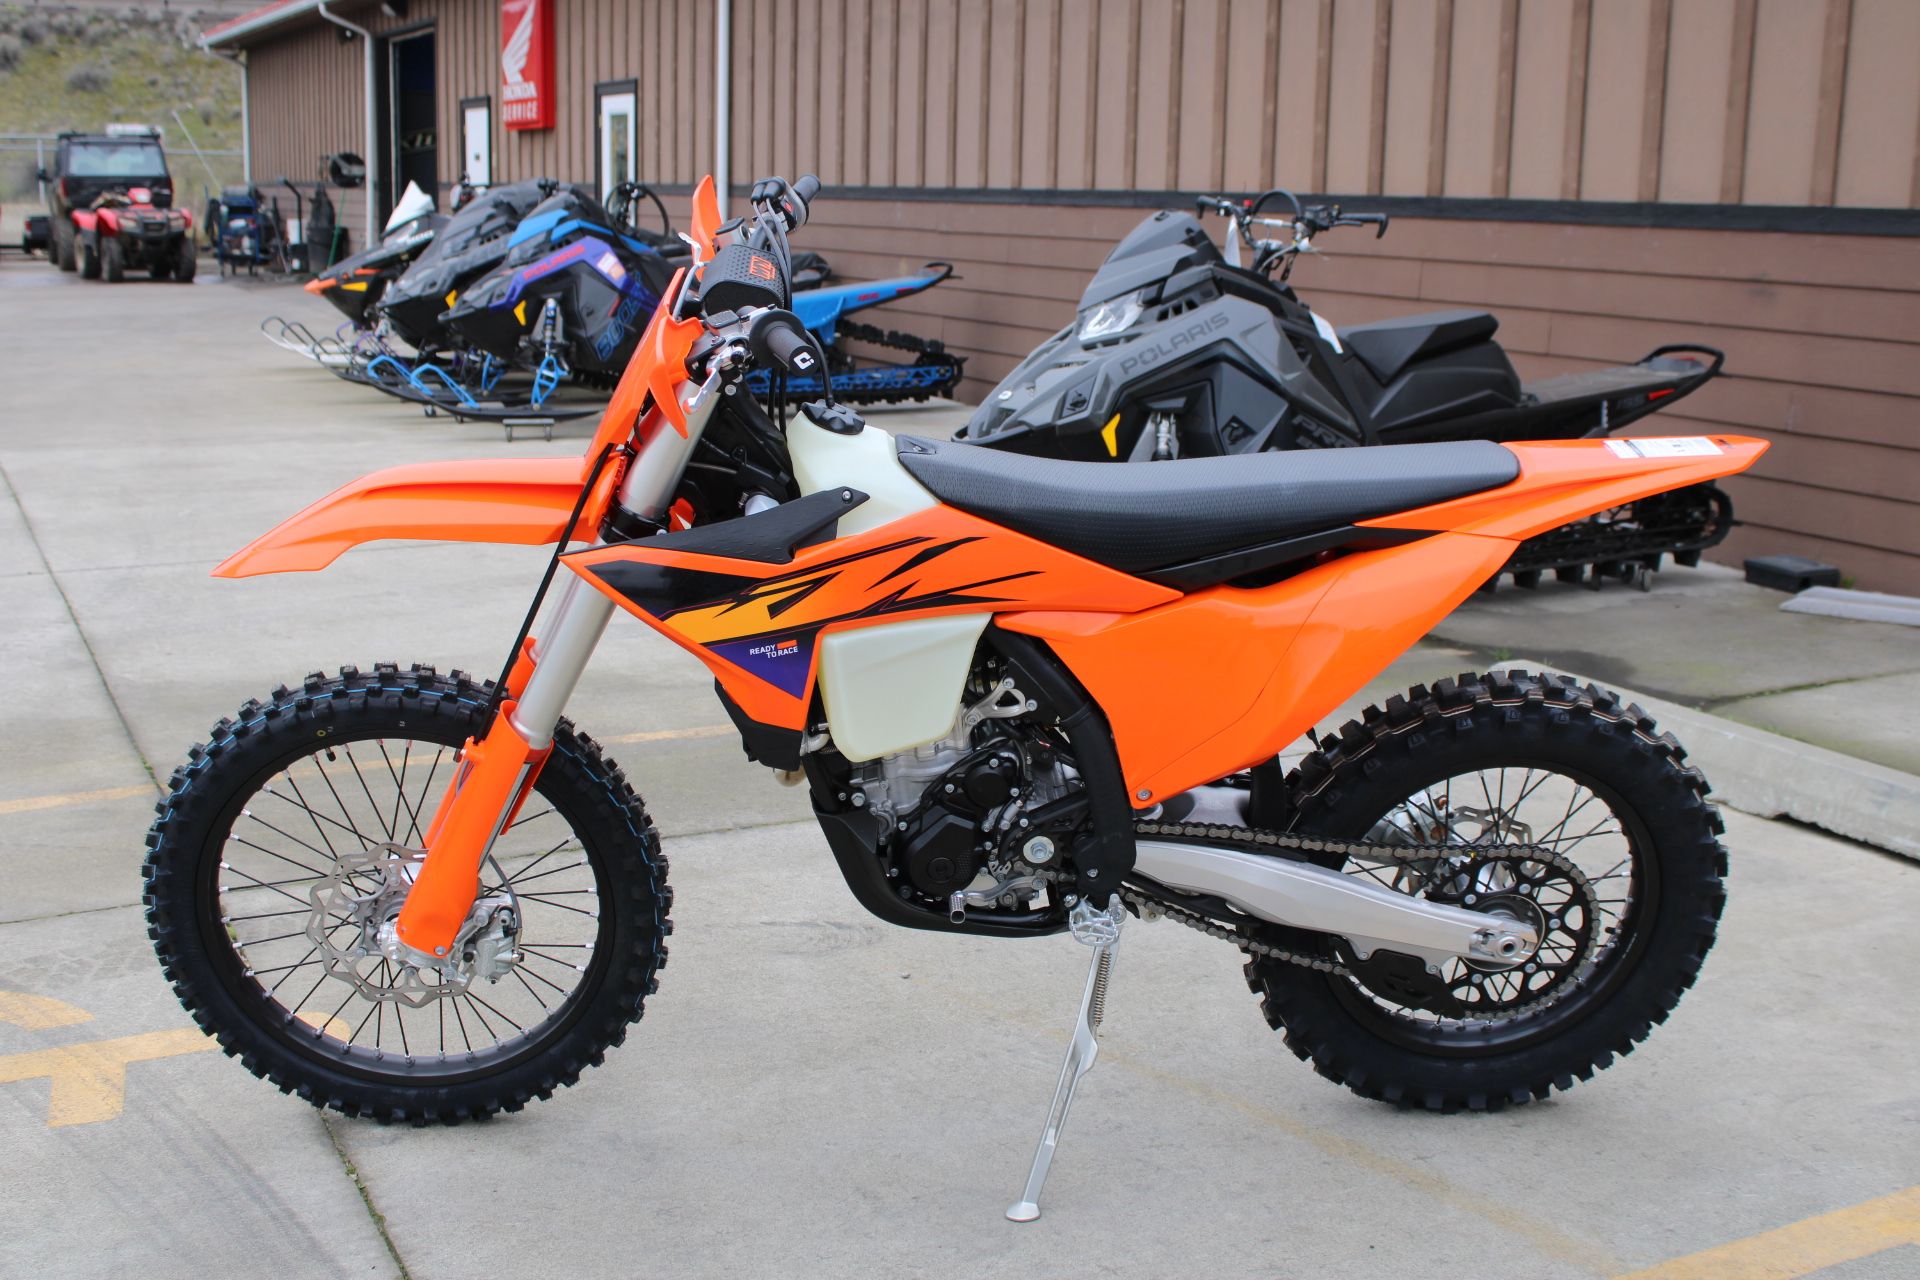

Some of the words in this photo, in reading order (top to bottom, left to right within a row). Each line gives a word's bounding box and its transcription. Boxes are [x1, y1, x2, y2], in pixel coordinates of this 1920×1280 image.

[1120, 311, 1231, 375] POLARIS
[749, 644, 776, 655] READY
[777, 646, 798, 656] RACE
